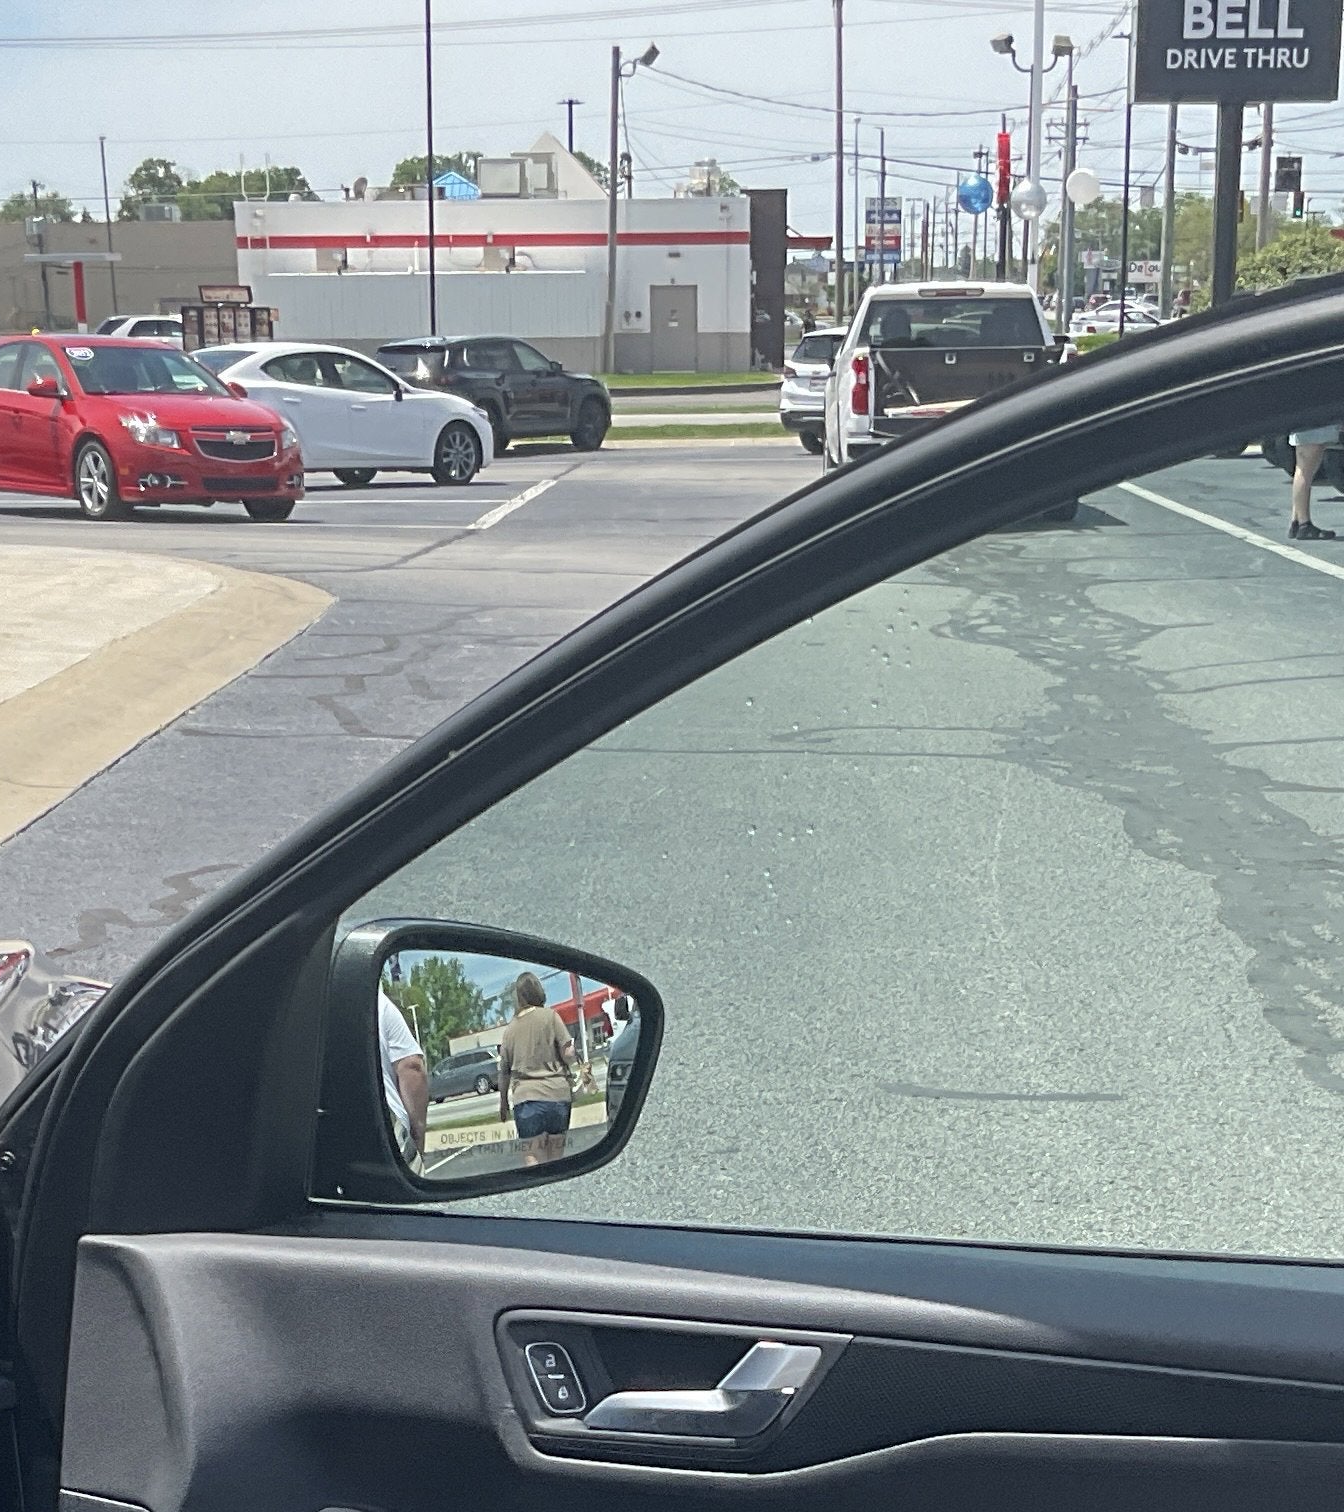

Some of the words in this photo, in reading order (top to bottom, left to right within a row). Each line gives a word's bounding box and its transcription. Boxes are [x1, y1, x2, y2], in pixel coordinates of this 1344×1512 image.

[1183, 0, 1304, 39] BELL
[1166, 47, 1236, 69] DRIVE
[1243, 47, 1309, 69] THRU
[440, 1130, 486, 1145] OBJECTS
[491, 1129, 502, 1140] IN
